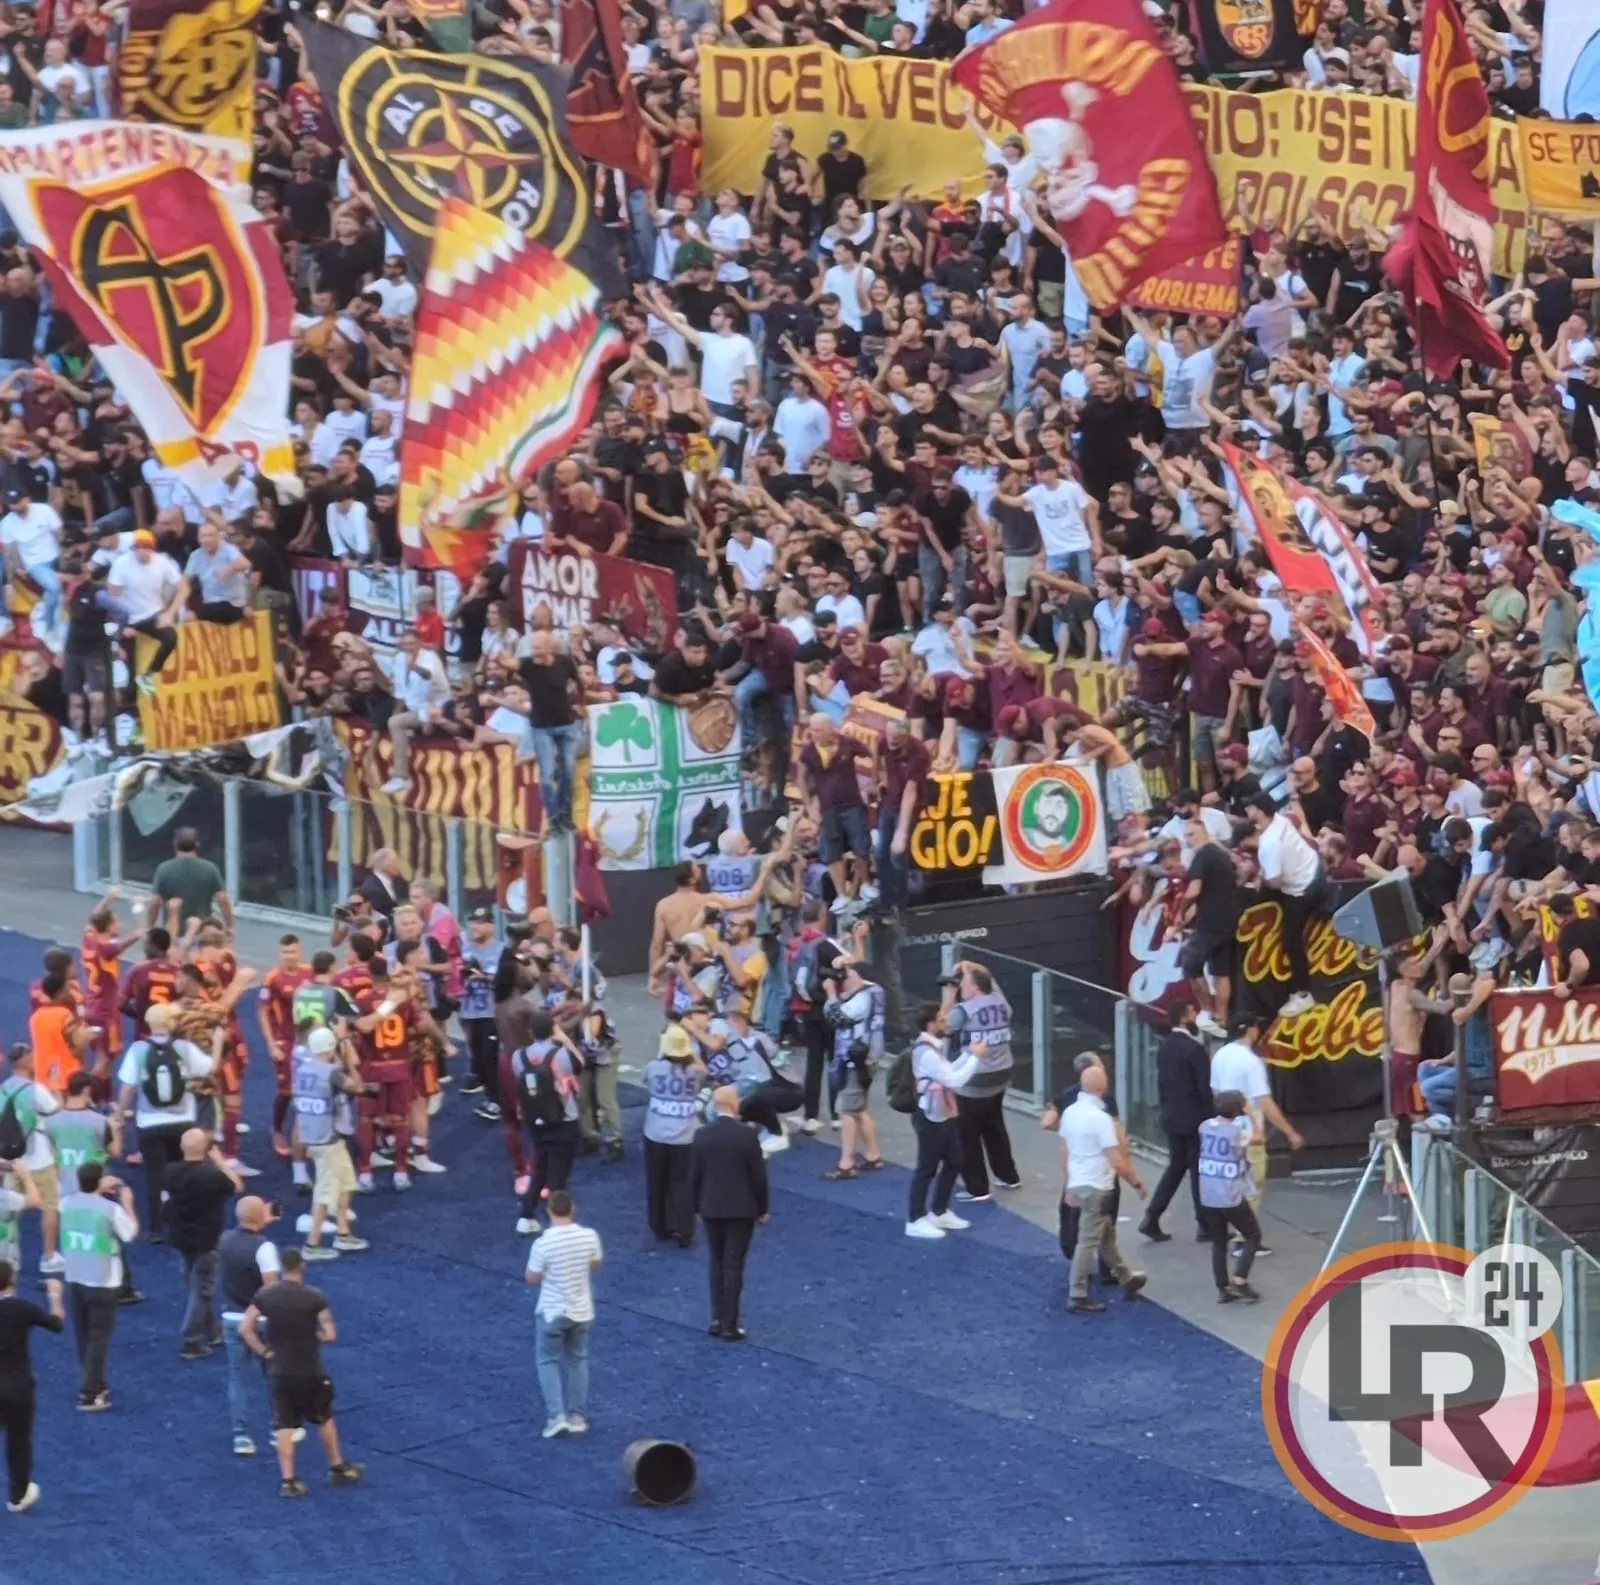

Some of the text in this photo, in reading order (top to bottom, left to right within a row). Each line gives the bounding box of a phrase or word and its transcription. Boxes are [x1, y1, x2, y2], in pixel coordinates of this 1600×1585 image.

[713, 52, 825, 118] DICE
[834, 60, 868, 119] IL
[1528, 132, 1563, 163] SE
[522, 550, 599, 598] AMOR
[910, 815, 998, 869] GIO!
[375, 1013, 406, 1049] 19
[60, 1148, 88, 1165] TV
[68, 1230, 95, 1250] TV
